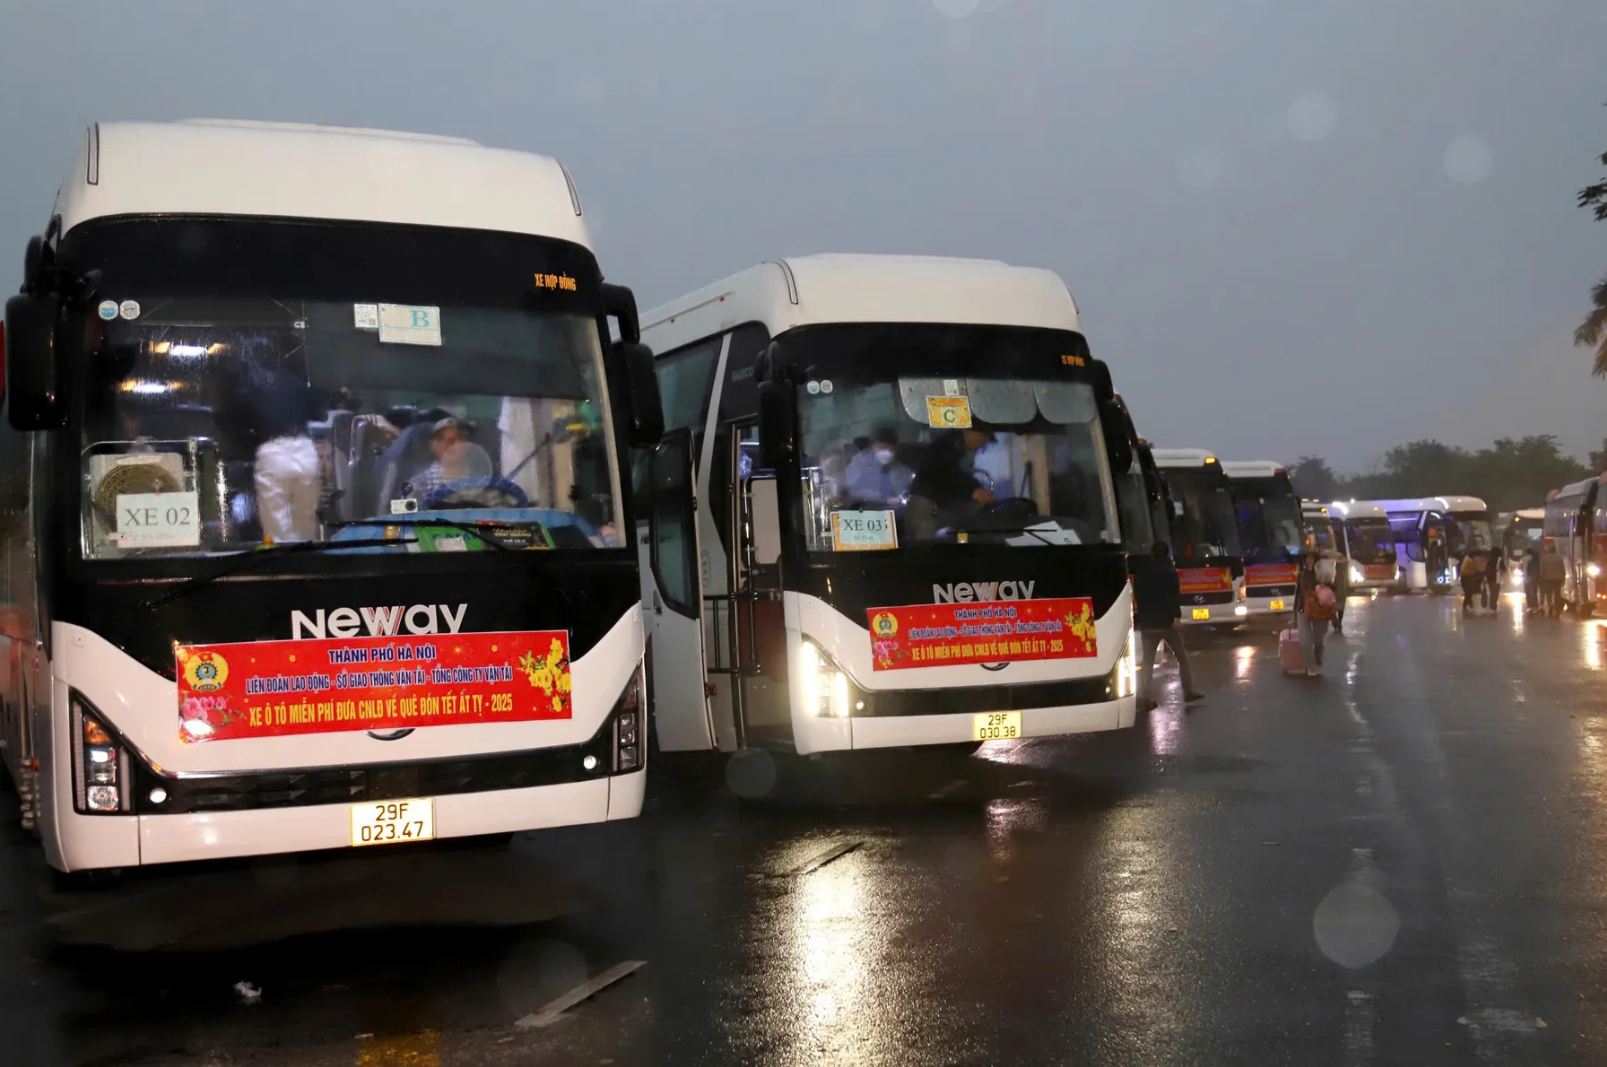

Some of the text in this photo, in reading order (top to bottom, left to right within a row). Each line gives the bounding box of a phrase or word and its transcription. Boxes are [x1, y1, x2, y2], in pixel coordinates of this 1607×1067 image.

[534, 273, 544, 287] XE
[411, 309, 429, 329] B
[943, 409, 956, 423] C
[124, 507, 190, 526] XE 02
[843, 519, 882, 531] XE 03
[954, 608, 977, 621] THÀNH
[329, 642, 436, 664] THÀNH PHỐ HÀ NỘI
[1050, 639, 1063, 653] 2025
[246, 676, 265, 694] LIÊN
[267, 674, 289, 692] ĐOÀN
[290, 676, 307, 691] LAO
[308, 672, 330, 694] ĐỘNG
[337, 669, 348, 688] SỞ
[349, 672, 367, 688] GIAO
[369, 669, 395, 687] THÔNG
[396, 668, 411, 689] VẬN
[412, 665, 425, 685] TẢI
[431, 664, 451, 683] TỔNG
[452, 665, 473, 683] CÔNG
[474, 668, 484, 682] TY
[484, 664, 500, 685] VẬN
[500, 661, 513, 681] TẢI
[249, 707, 262, 727] XE
[264, 703, 272, 726] Ô
[274, 701, 287, 725] TÔ
[289, 697, 315, 723] MIỄN
[317, 699, 334, 722] PHÍ
[336, 701, 356, 721] ĐƯA
[358, 699, 383, 719] CNLĐ
[400, 694, 418, 718] QUÊ
[420, 691, 440, 715] ĐÓN
[441, 689, 457, 714] TẾT
[459, 689, 470, 713] ẤT
[472, 694, 483, 717] TỴ
[491, 693, 513, 712] 2025
[988, 714, 1007, 726] 29F
[980, 726, 1016, 738] 030.38
[375, 803, 409, 821] 29F
[361, 821, 424, 842] 023.47
